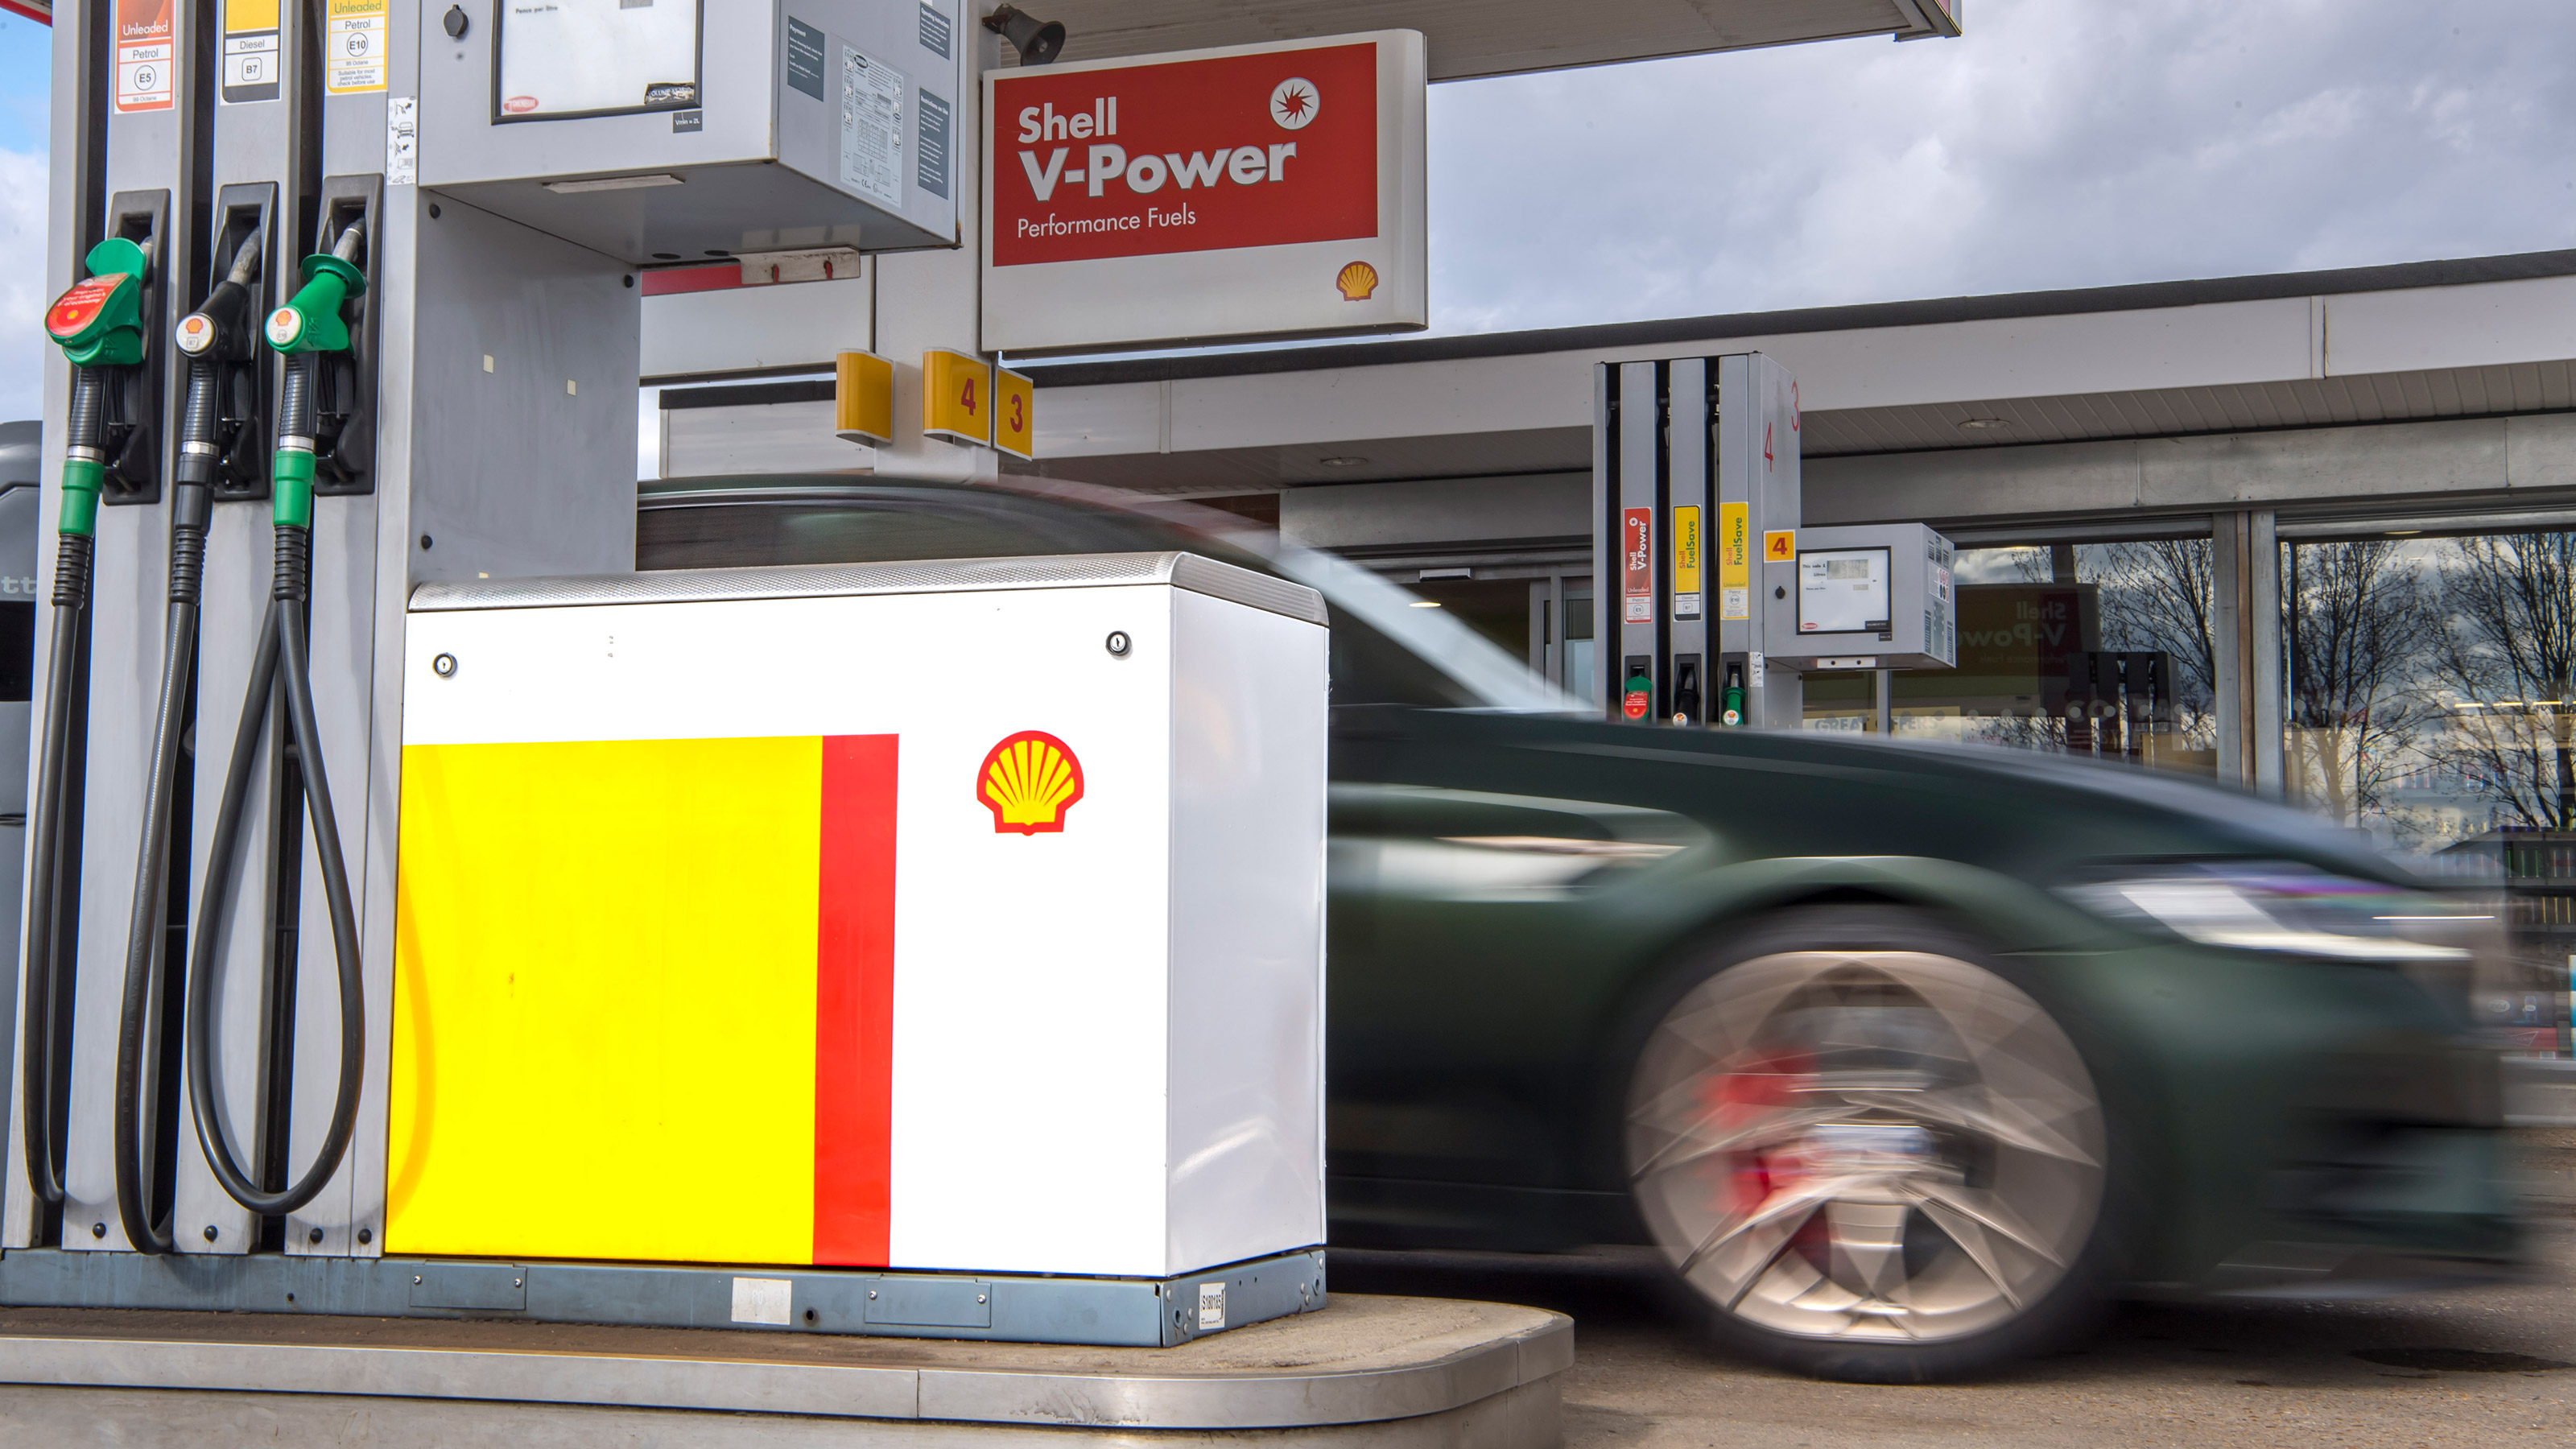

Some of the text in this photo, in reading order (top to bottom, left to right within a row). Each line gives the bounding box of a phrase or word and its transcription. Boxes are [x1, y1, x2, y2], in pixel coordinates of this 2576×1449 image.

[334, 0, 382, 14] Unleaded
[345, 19, 370, 30] Petrol
[122, 19, 168, 36] Unleaded
[240, 39, 265, 50] Diesel
[349, 39, 366, 50] E10
[133, 48, 159, 59] Petrol
[246, 65, 258, 74] B7
[139, 73, 151, 83] E5
[1018, 96, 1117, 143] Shell
[1018, 142, 1297, 202] V-Power
[1018, 202, 1196, 238] Performance Fuels
[960, 378, 976, 416] 4
[1009, 394, 1023, 433] 3
[1791, 380, 1799, 431] 3
[1765, 422, 1773, 473] 4
[1637, 521, 1647, 570] V-Power
[1686, 521, 1695, 568] FuelSave
[1733, 518, 1743, 565] FuelSave
[1772, 537, 1787, 555] 4
